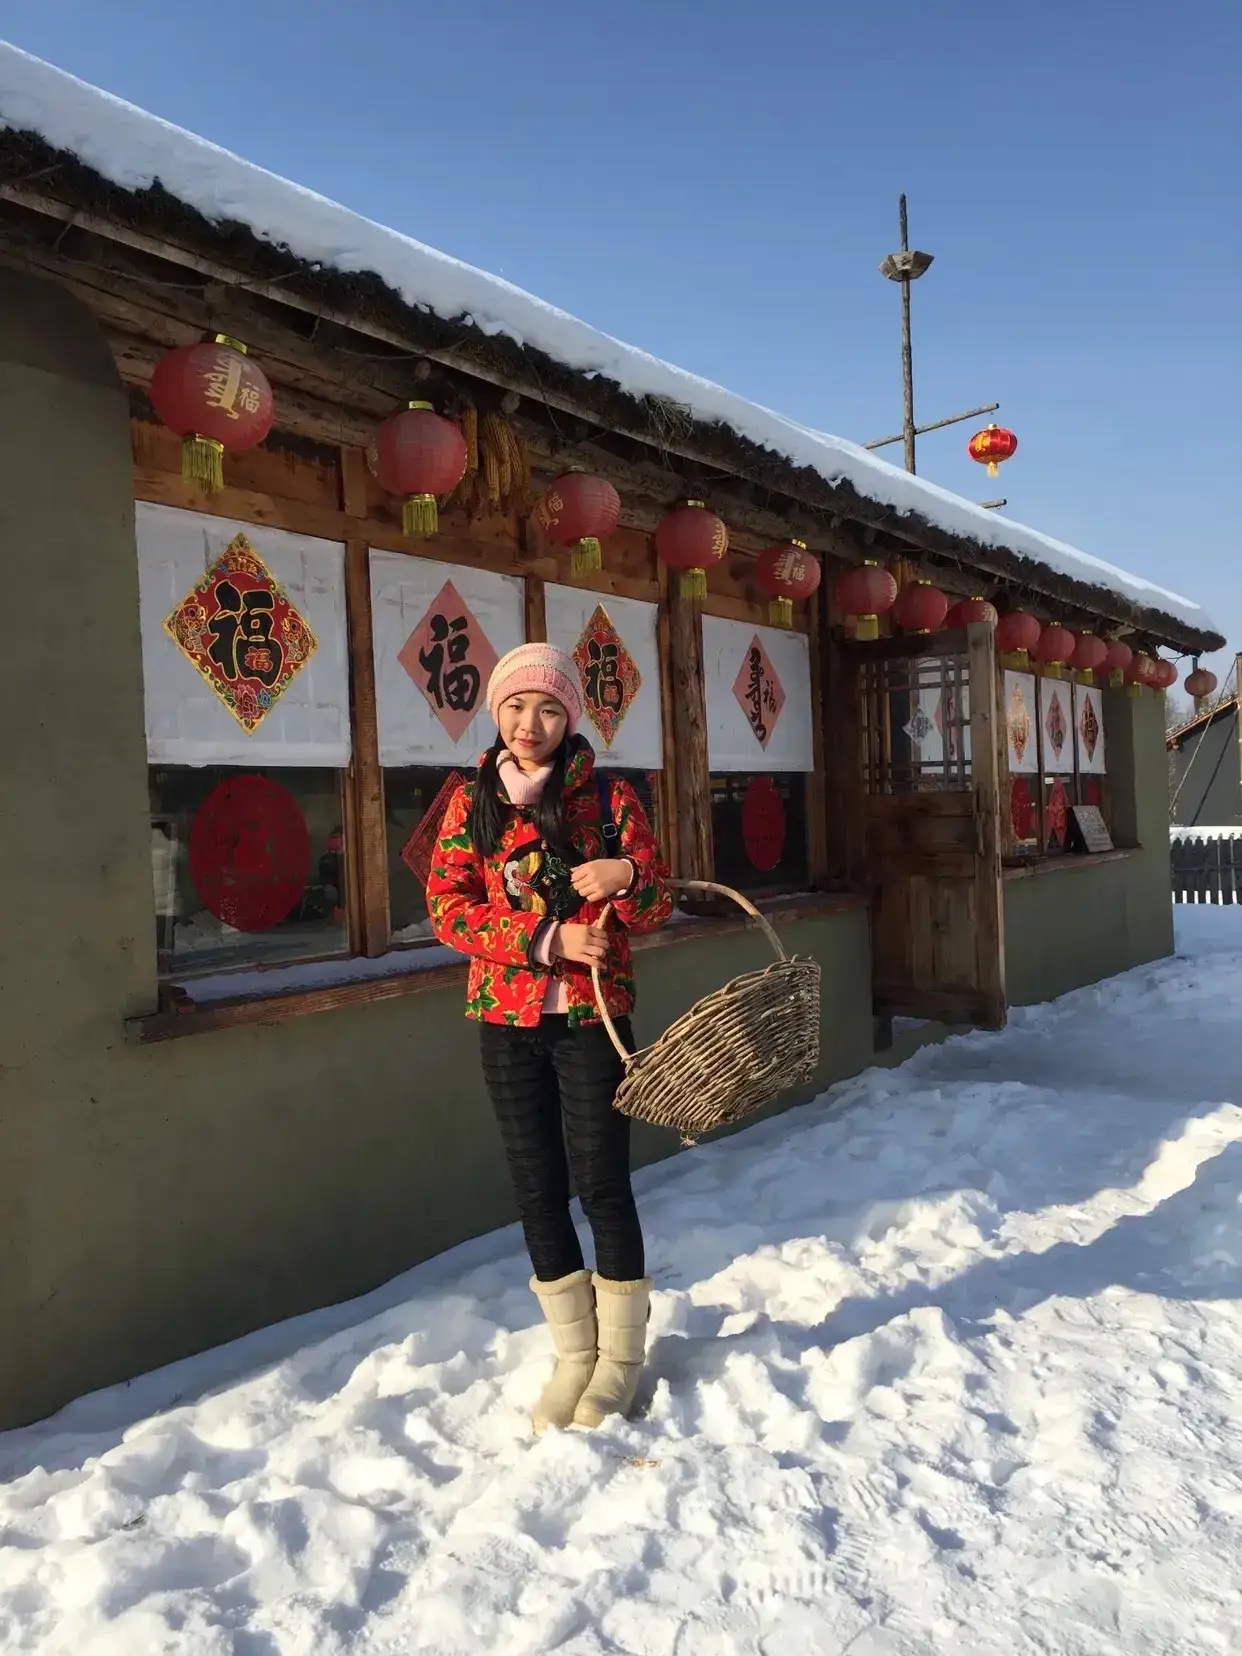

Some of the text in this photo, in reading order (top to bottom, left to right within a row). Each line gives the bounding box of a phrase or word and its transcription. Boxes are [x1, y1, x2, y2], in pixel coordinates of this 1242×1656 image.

[239, 381, 260, 413] 福
[207, 580, 284, 688] 福
[244, 646, 273, 672] 福
[419, 614, 480, 711] 福
[584, 637, 625, 714] 福
